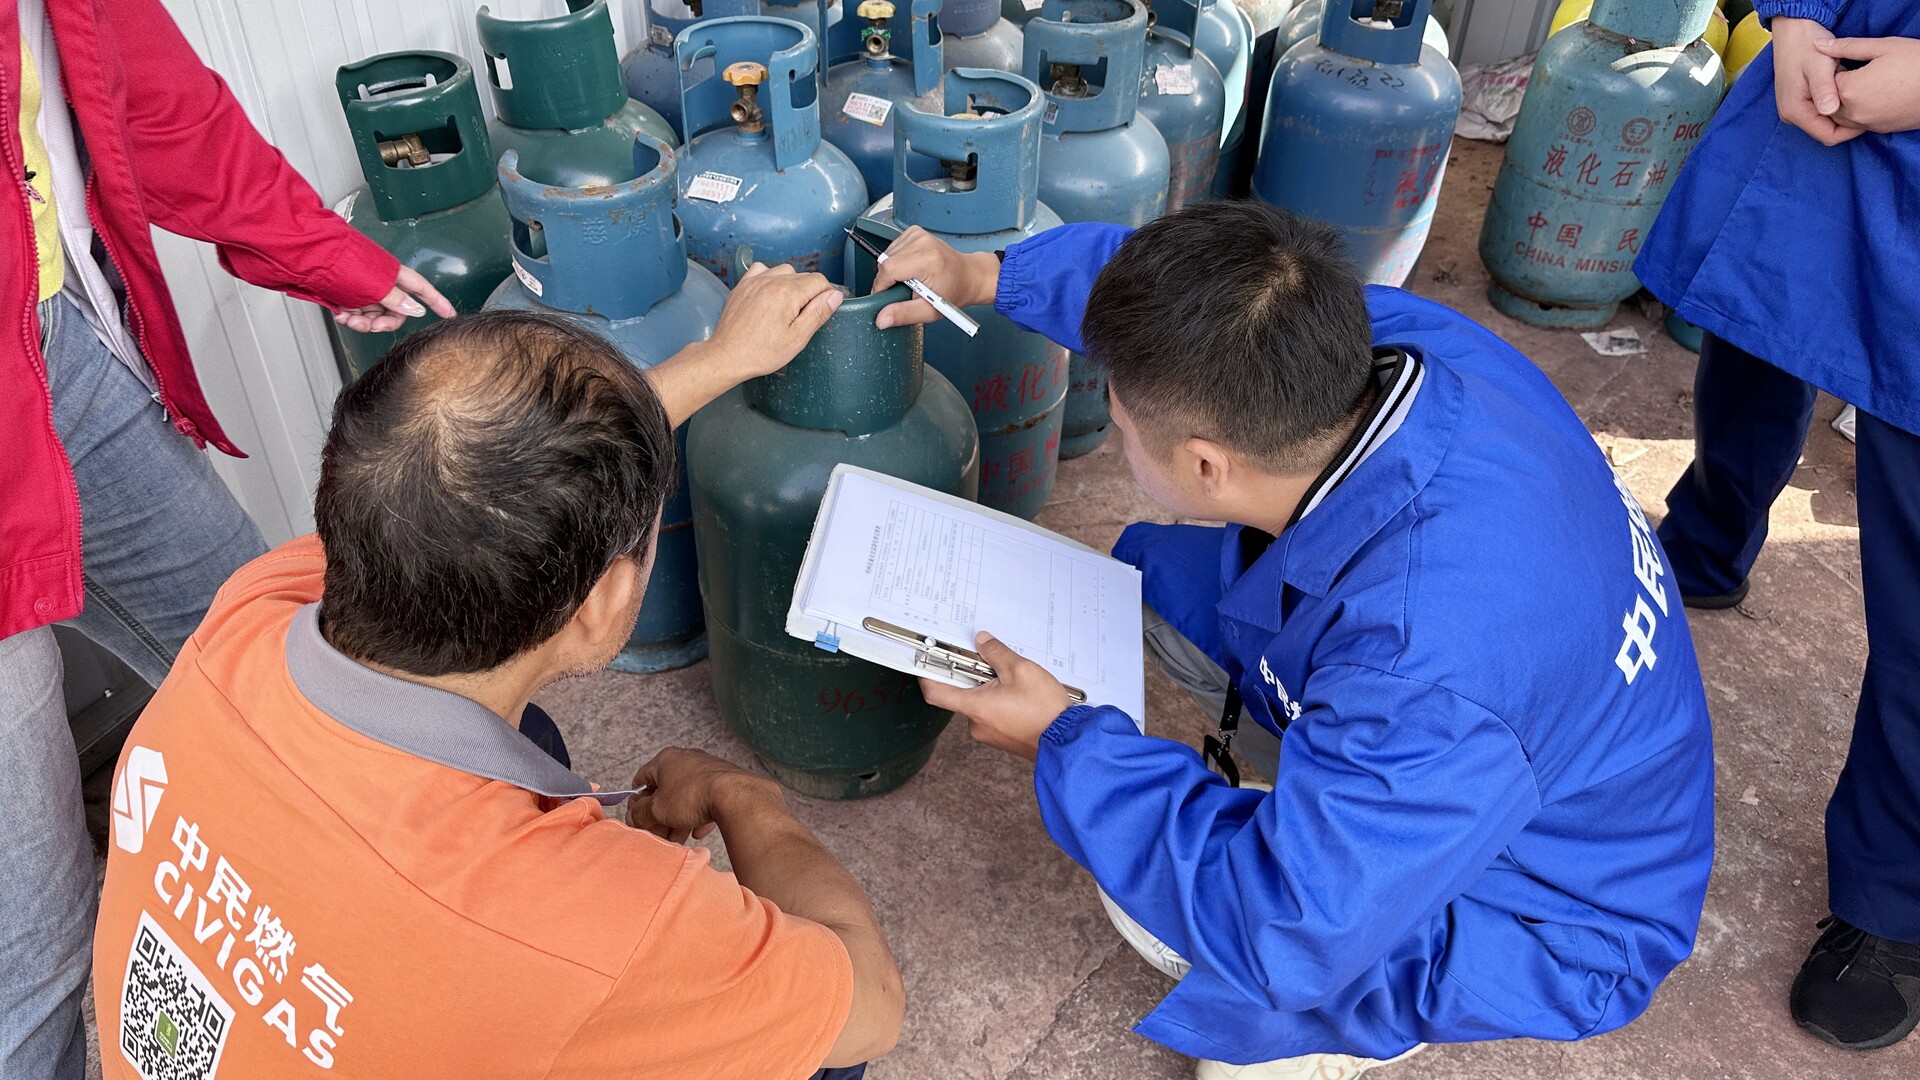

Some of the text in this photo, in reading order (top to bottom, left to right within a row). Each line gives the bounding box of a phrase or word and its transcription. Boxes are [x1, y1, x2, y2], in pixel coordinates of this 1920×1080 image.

[1379, 71, 1405, 92] 22
[1542, 144, 1684, 188] 液化石油
[1514, 242, 1634, 274] CHINA MINSH
[170, 815, 354, 1037] 中民燃气
[153, 861, 337, 1069] CIVIGAS
